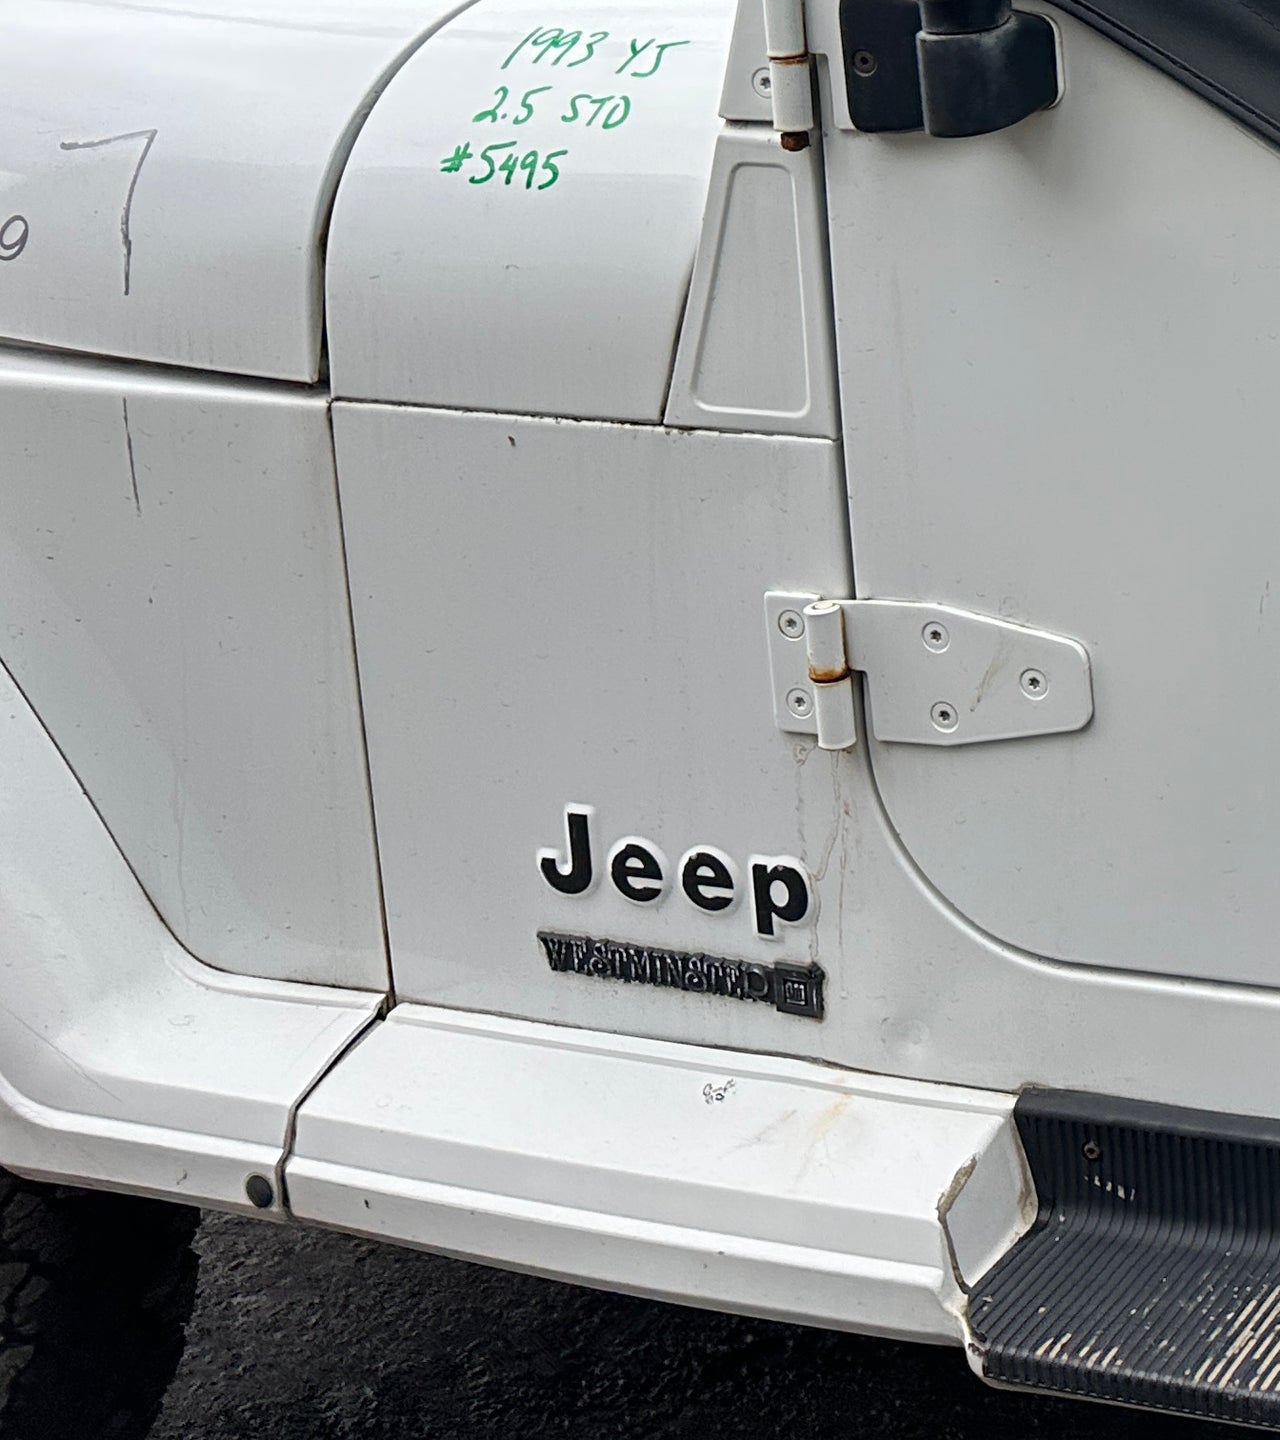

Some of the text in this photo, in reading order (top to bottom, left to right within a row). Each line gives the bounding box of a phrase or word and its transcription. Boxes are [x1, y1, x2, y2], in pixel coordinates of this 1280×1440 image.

[501, 27, 691, 78] 1993 YJ
[472, 85, 631, 130] 2.5 STD
[440, 141, 568, 190] #5495
[536, 802, 815, 941] Jeep
